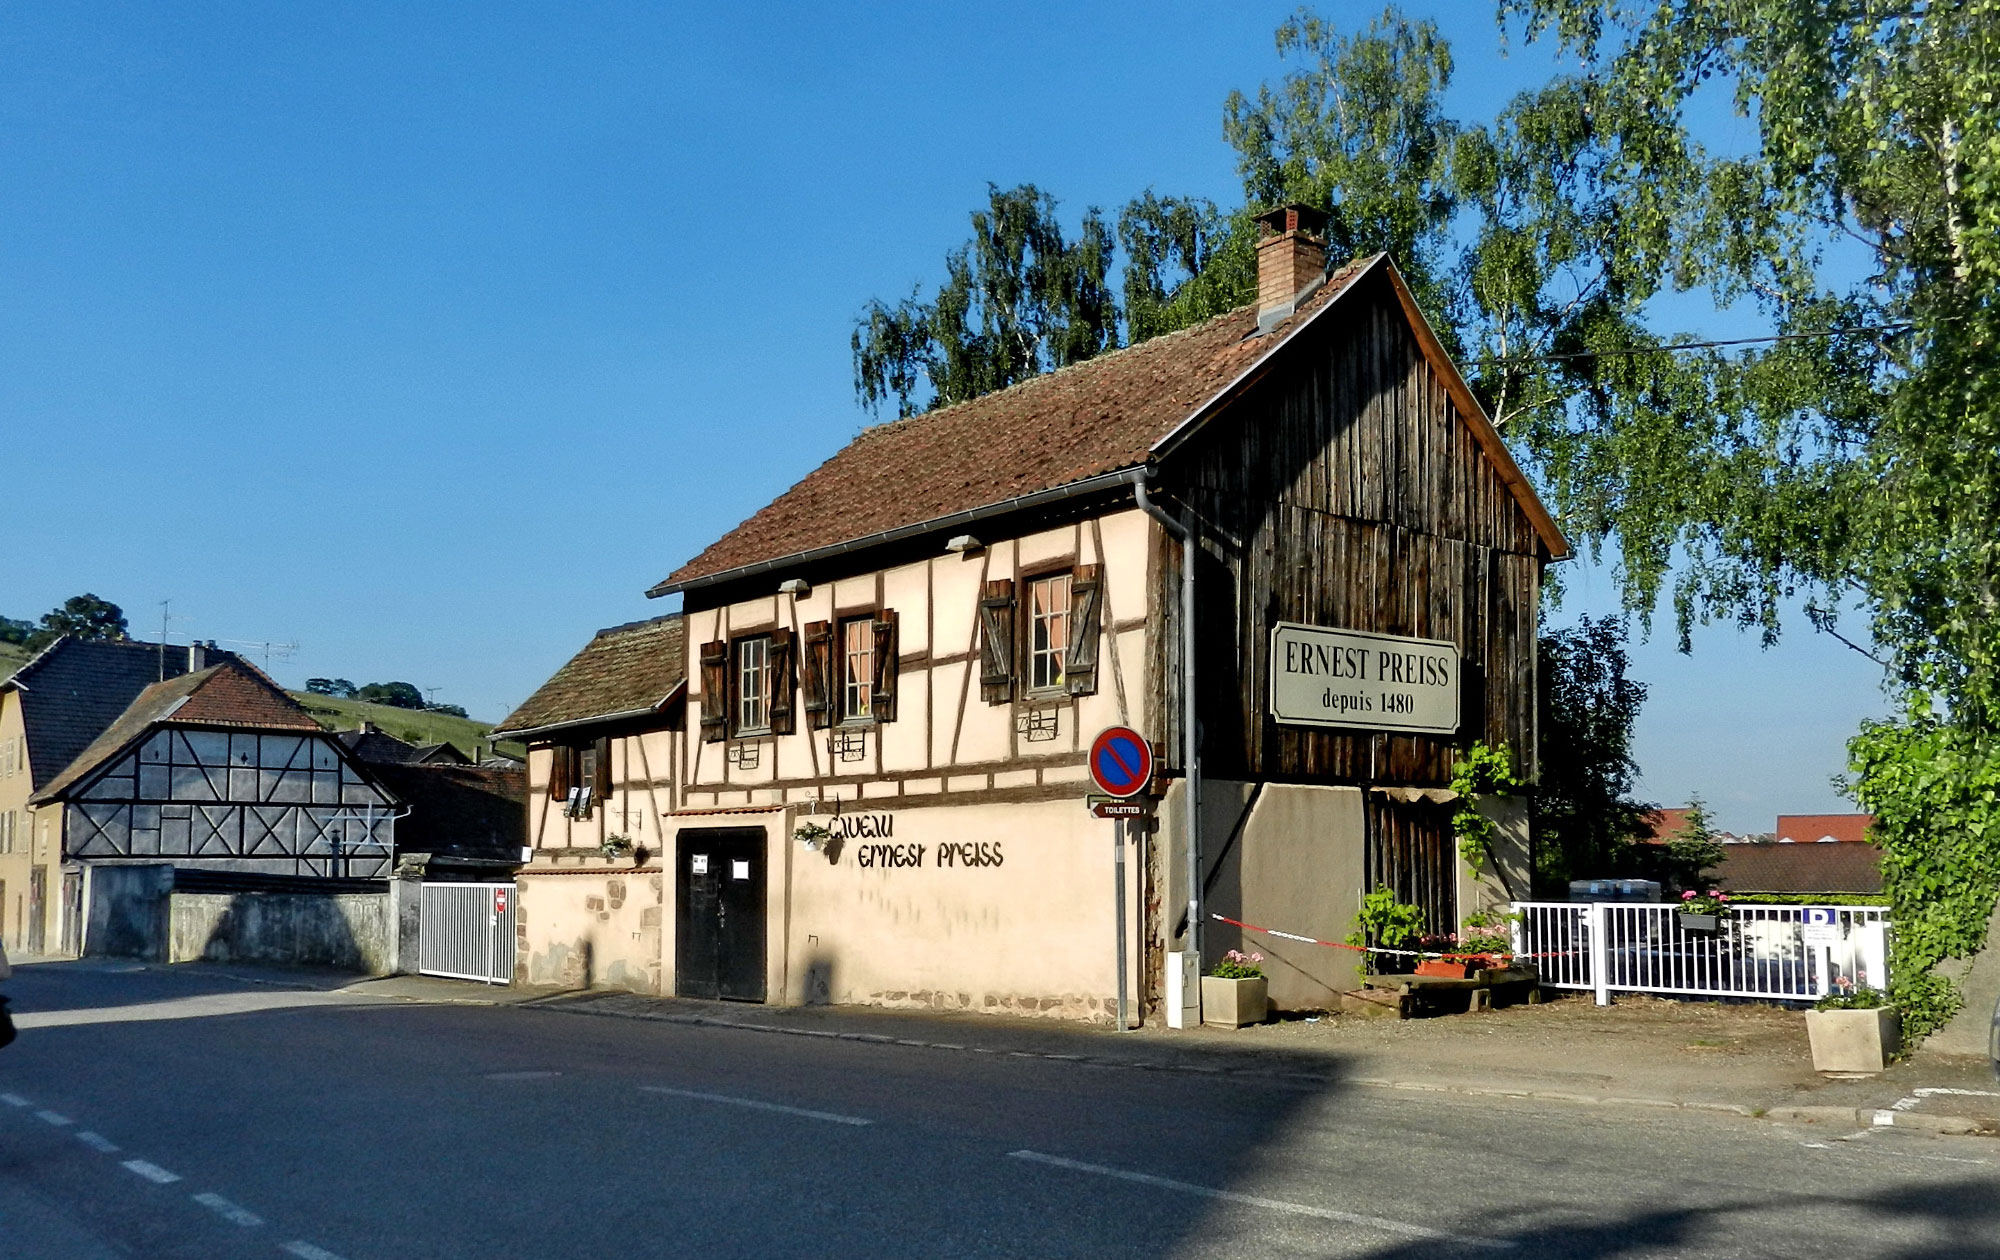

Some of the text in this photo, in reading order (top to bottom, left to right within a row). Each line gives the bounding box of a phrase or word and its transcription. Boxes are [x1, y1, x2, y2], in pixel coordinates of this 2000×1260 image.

[1285, 640, 1449, 687] ERNEST PREISS
[1322, 687, 1414, 715] depuis 1480
[1104, 806, 1140, 814] TOILETTES
